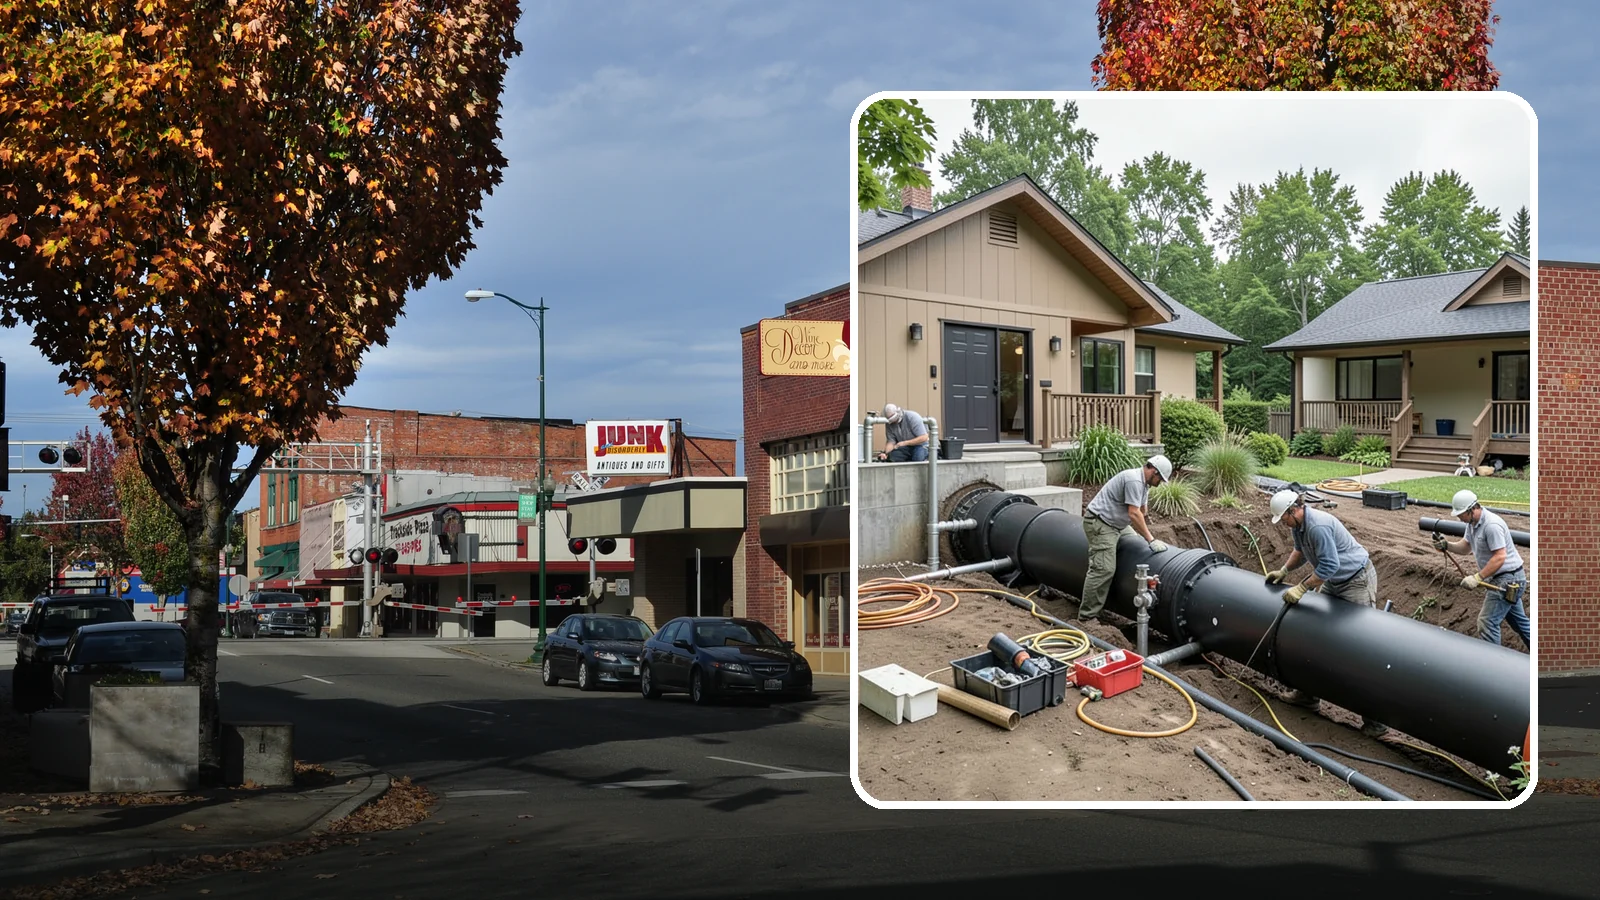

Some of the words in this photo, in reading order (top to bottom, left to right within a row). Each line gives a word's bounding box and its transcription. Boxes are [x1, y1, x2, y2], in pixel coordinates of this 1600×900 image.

[595, 425, 665, 457] JUNK
[607, 446, 646, 454] DISORDERLY
[597, 461, 628, 470] ANTIQUES
[631, 461, 644, 470] AND
[646, 460, 665, 469] GIFTS
[573, 473, 589, 492] RAIL
[390, 522, 413, 539] Trackside
[414, 520, 429, 535] Pizza
